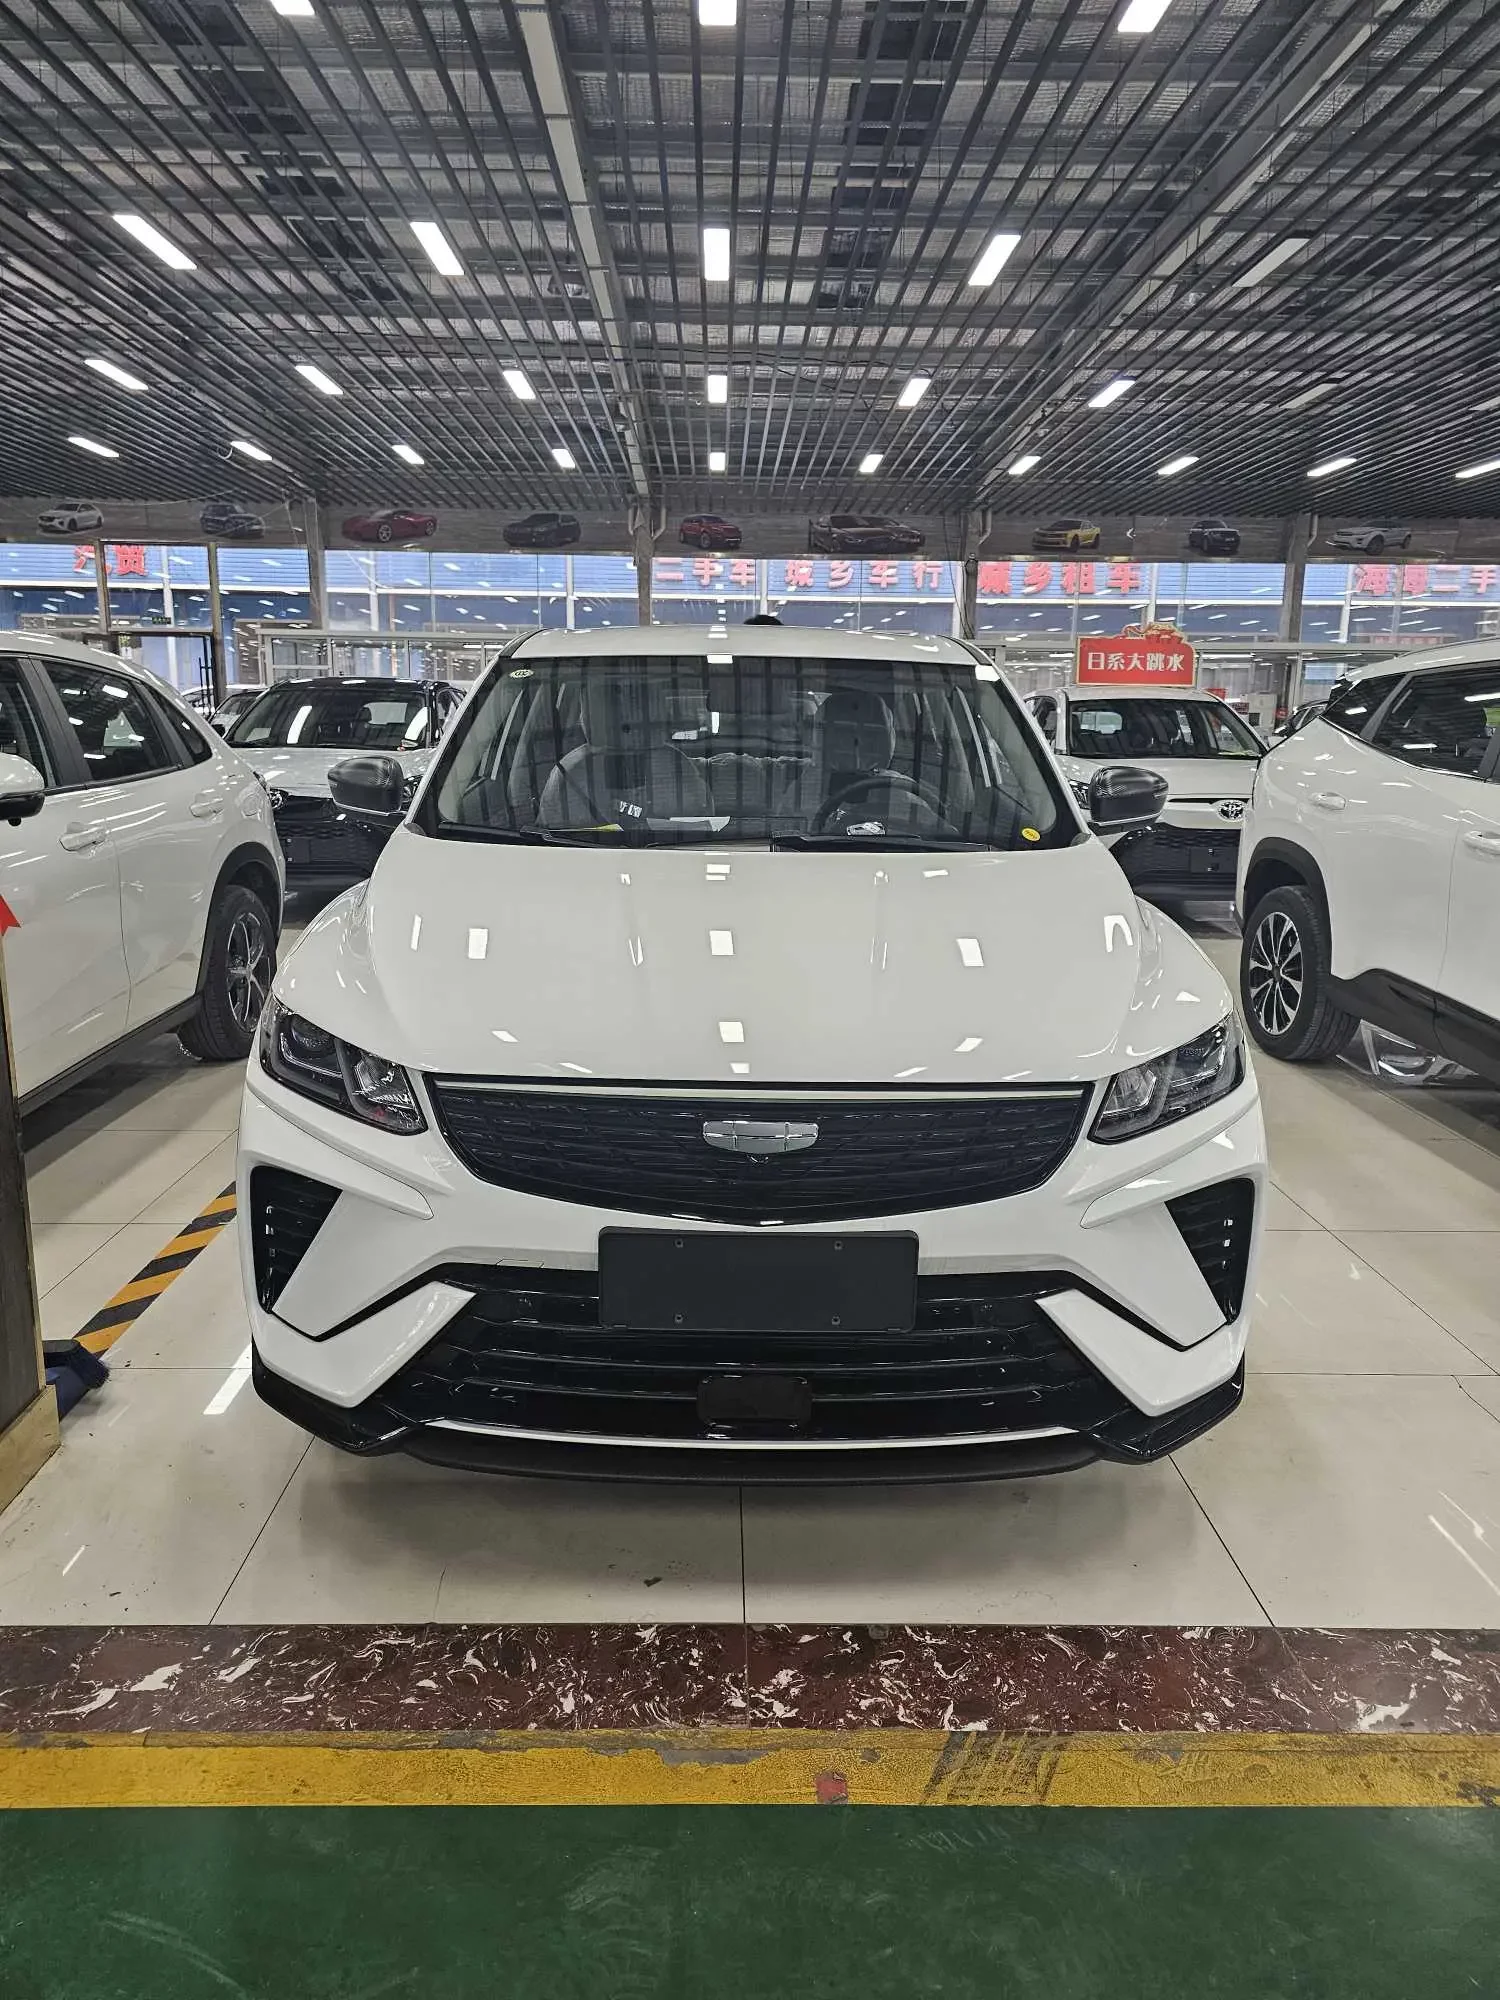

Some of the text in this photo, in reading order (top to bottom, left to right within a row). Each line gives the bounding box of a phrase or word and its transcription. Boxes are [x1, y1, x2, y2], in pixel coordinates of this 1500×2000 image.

[655, 558, 756, 587] 二手车
[1088, 652, 1185, 672] 日系大跳水
